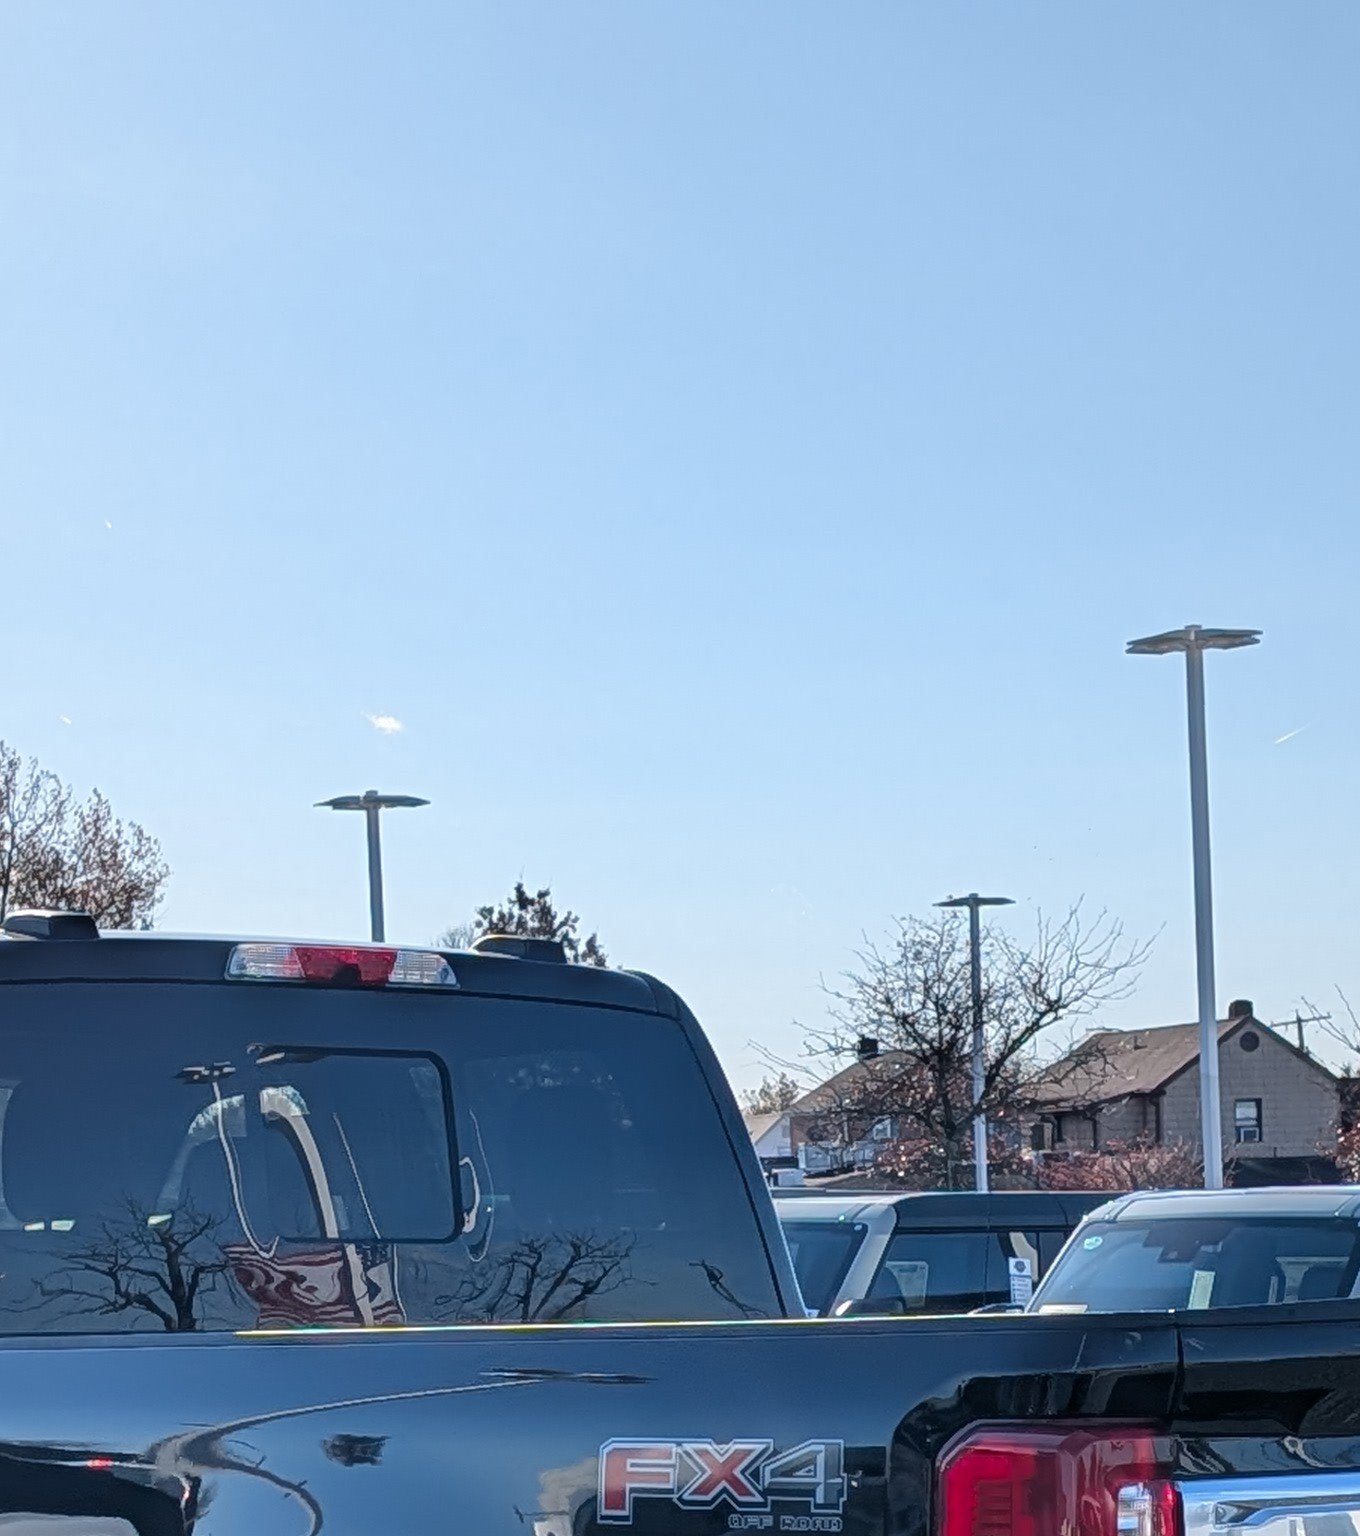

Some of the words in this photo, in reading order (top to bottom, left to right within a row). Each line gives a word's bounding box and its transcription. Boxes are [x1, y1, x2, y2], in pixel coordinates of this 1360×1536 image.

[597, 1438, 847, 1524] FX4
[729, 1514, 774, 1530] OFF
[780, 1514, 843, 1532] ROAD
